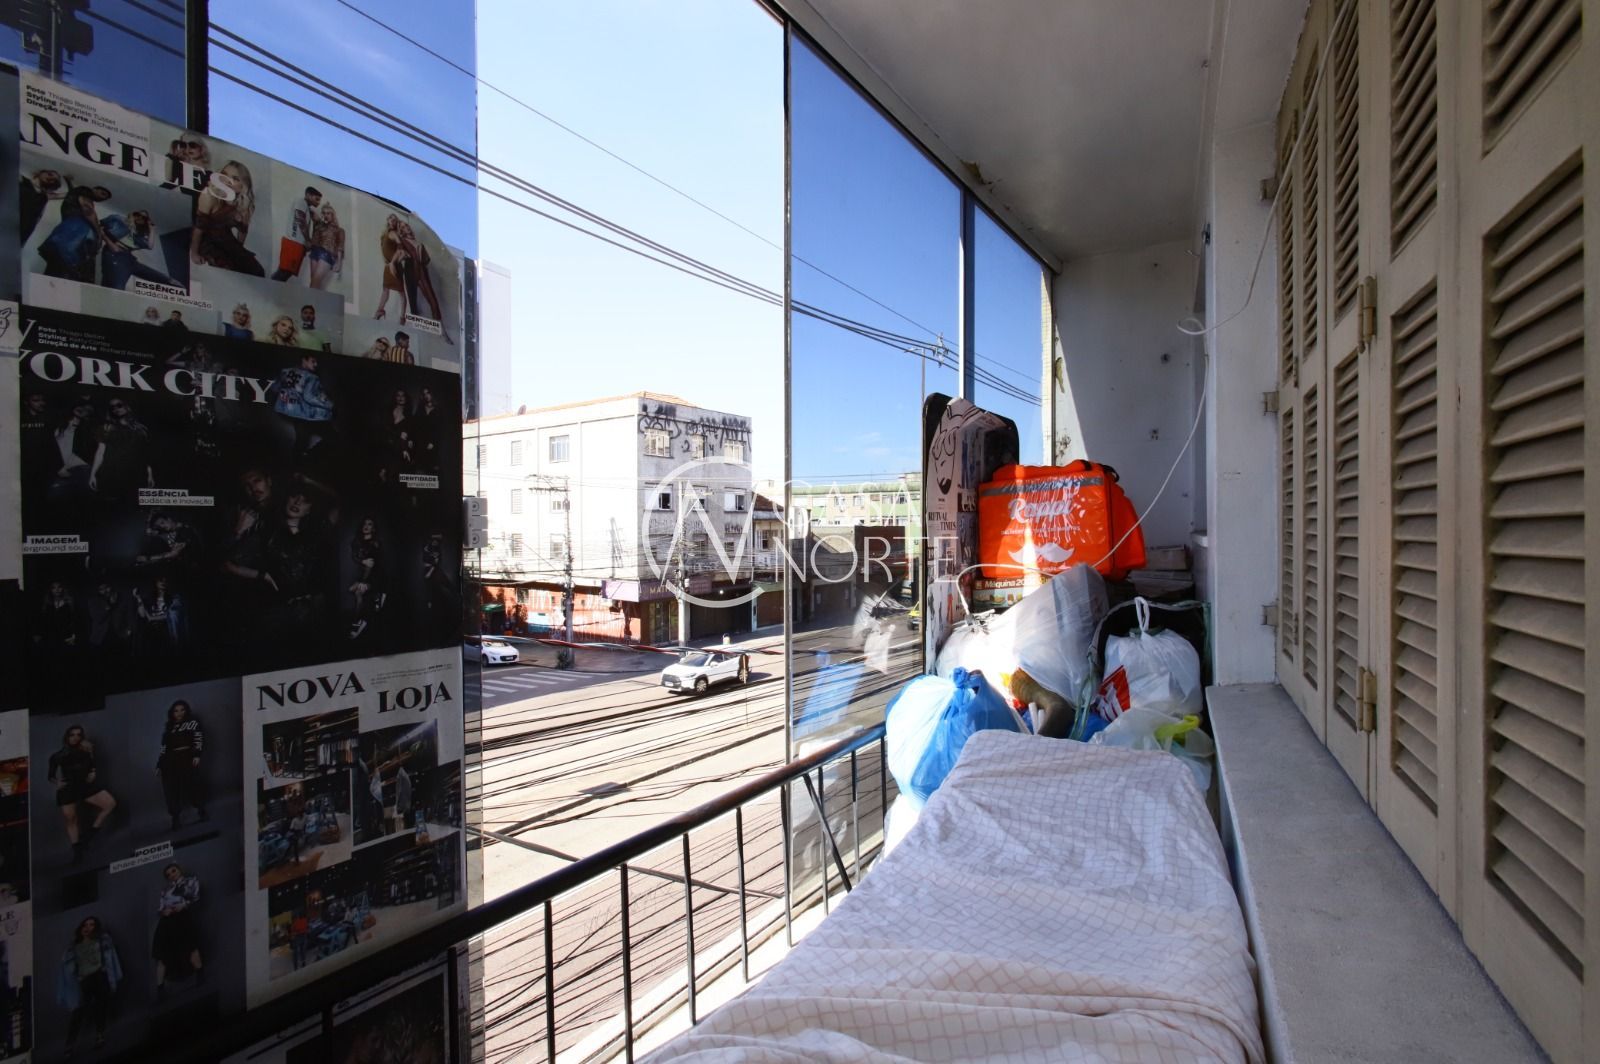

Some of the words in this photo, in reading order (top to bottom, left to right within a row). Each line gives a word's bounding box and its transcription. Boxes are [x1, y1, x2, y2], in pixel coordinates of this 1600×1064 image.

[26, 84, 46, 95] Foto
[26, 91, 57, 106] Styling
[26, 98, 58, 113] Direção
[59, 109, 70, 117] de
[71, 113, 89, 123] Arte
[135, 280, 186, 297] ESSÊNCIA
[37, 325, 57, 334] Foto
[37, 331, 67, 342] Styling
[37, 338, 69, 349] Direção
[80, 344, 97, 352] Arte
[163, 368, 275, 403] CITY
[139, 489, 187, 497] ESSÊNCIA
[1008, 494, 1073, 524] Rappi
[256, 672, 366, 710] NOVA
[377, 681, 453, 713] LOJA
[136, 843, 169, 857] PODER
